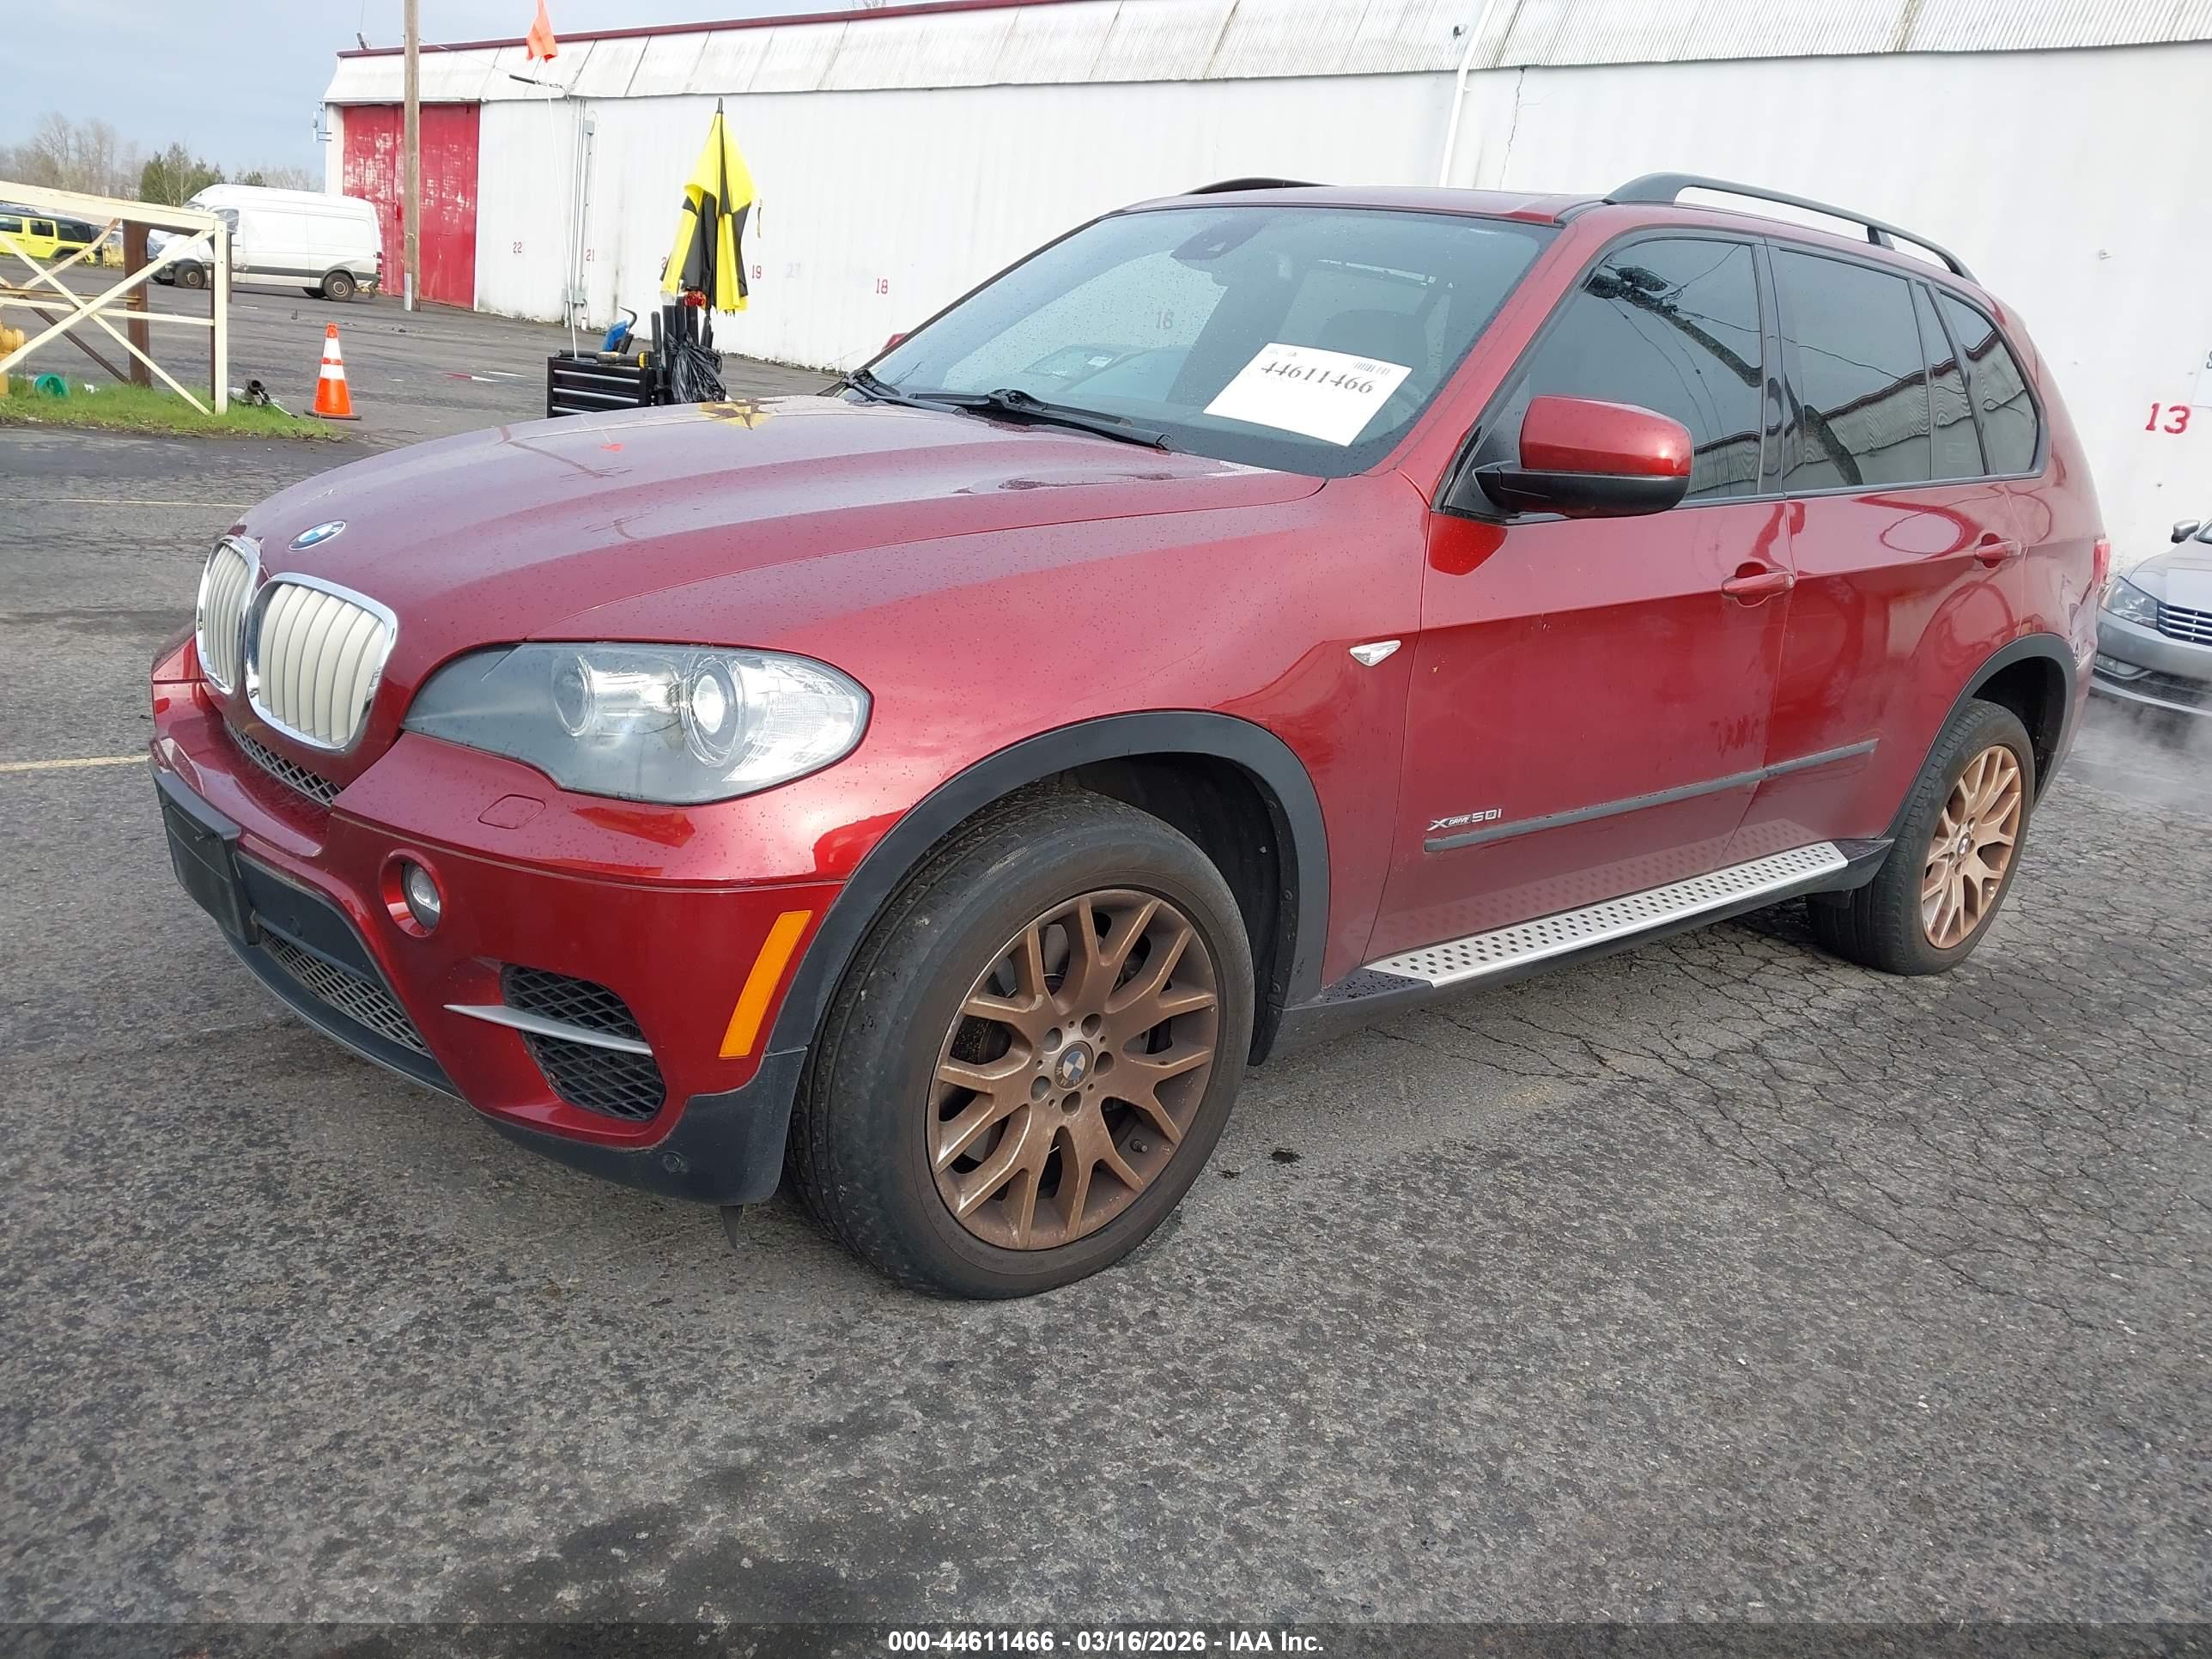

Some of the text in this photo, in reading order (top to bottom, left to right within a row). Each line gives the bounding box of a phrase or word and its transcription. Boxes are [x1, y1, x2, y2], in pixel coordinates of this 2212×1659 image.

[513, 241, 523, 254] 22
[586, 249, 595, 262] 21
[751, 264, 762, 279] 19
[876, 278, 888, 295] 18
[1261, 362, 1375, 393] 44611466
[2145, 403, 2191, 434] 13
